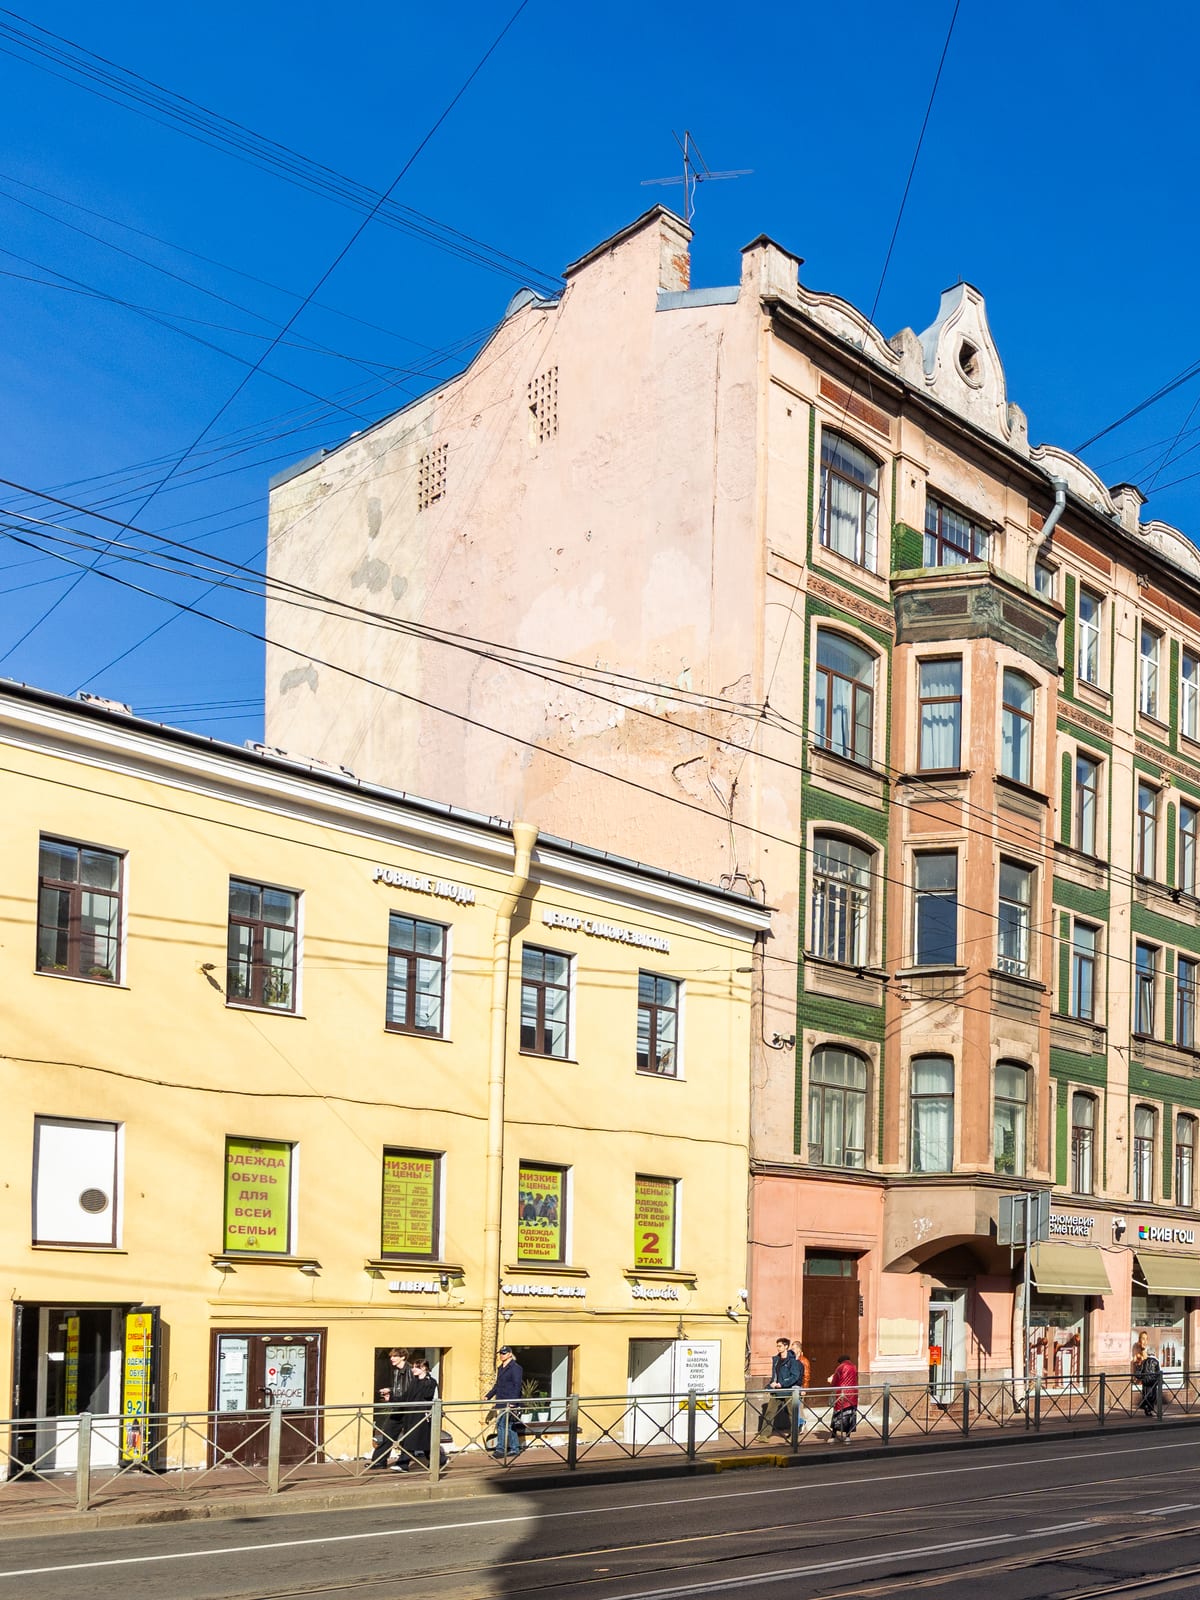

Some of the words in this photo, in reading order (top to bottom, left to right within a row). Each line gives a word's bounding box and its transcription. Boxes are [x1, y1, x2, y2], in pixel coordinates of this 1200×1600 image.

[373, 867, 433, 894] РОВНЫЕ
[434, 880, 475, 904] ЛЮДИ
[543, 908, 581, 929] ЦЕНТР
[584, 919, 670, 952] САМОРАЗВИТИЯ
[226, 1154, 286, 1168] ОДЕЖДА
[384, 1160, 432, 1173] НИЗКИЕ
[231, 1172, 278, 1184] ОБУВЬ
[393, 1170, 422, 1178] ЦЕНЫ
[519, 1173, 558, 1183] НИЗКИЕ
[527, 1182, 551, 1190] ЦЕНЫ
[640, 1187, 664, 1196] ЦЕНЫ
[239, 1190, 269, 1201] ДЛЯ
[635, 1199, 668, 1207] ОДЕЖДА
[234, 1207, 272, 1218] ВСЕЙ
[638, 1220, 664, 1228] СЕМЬИ
[1050, 1214, 1095, 1227] фюмерия
[228, 1224, 277, 1236] СЕМЬИ
[520, 1228, 554, 1236] ОДЕЖДА
[1050, 1223, 1089, 1236] сметика
[1150, 1226, 1171, 1243] РИВ
[1174, 1229, 1194, 1243] ГОШ
[641, 1232, 660, 1254] 2
[637, 1257, 663, 1265] ЭТАЖ
[389, 1280, 440, 1292] ШАВЕРМА
